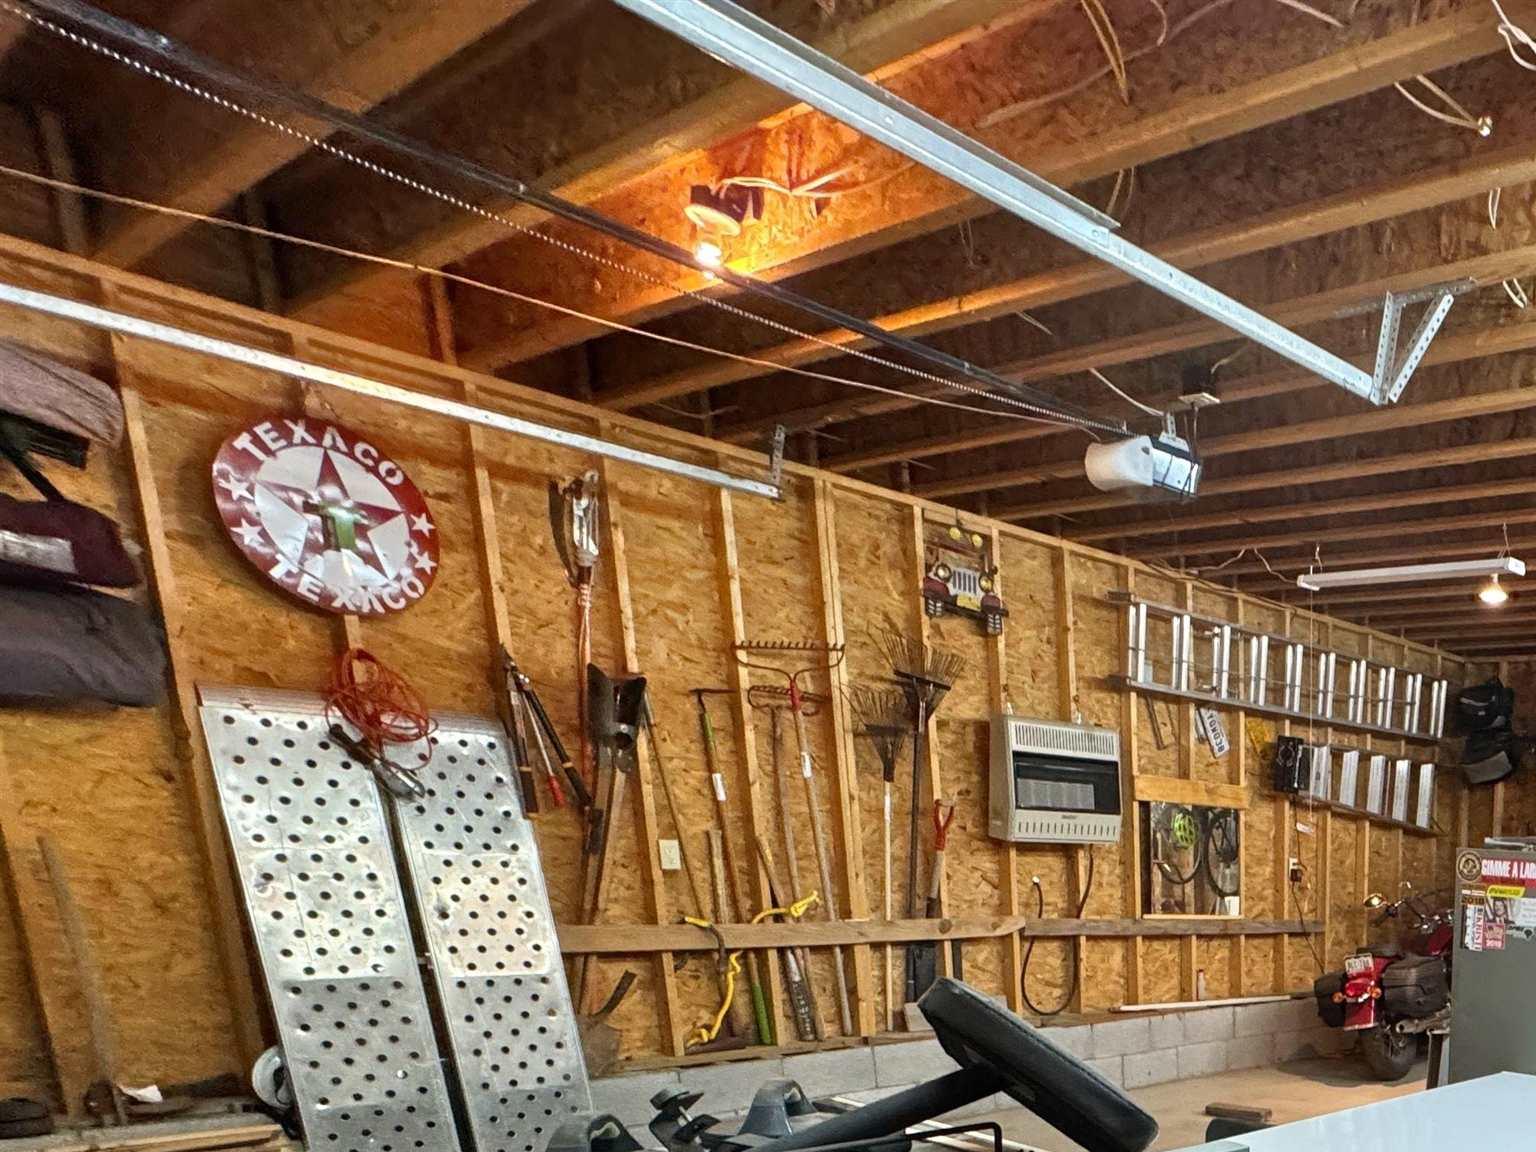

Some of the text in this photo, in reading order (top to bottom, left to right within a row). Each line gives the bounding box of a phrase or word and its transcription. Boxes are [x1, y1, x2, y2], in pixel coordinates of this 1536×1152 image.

[232, 419, 404, 486] TEXACO
[268, 553, 426, 614] TEXACO
[1511, 861, 1519, 879] A
